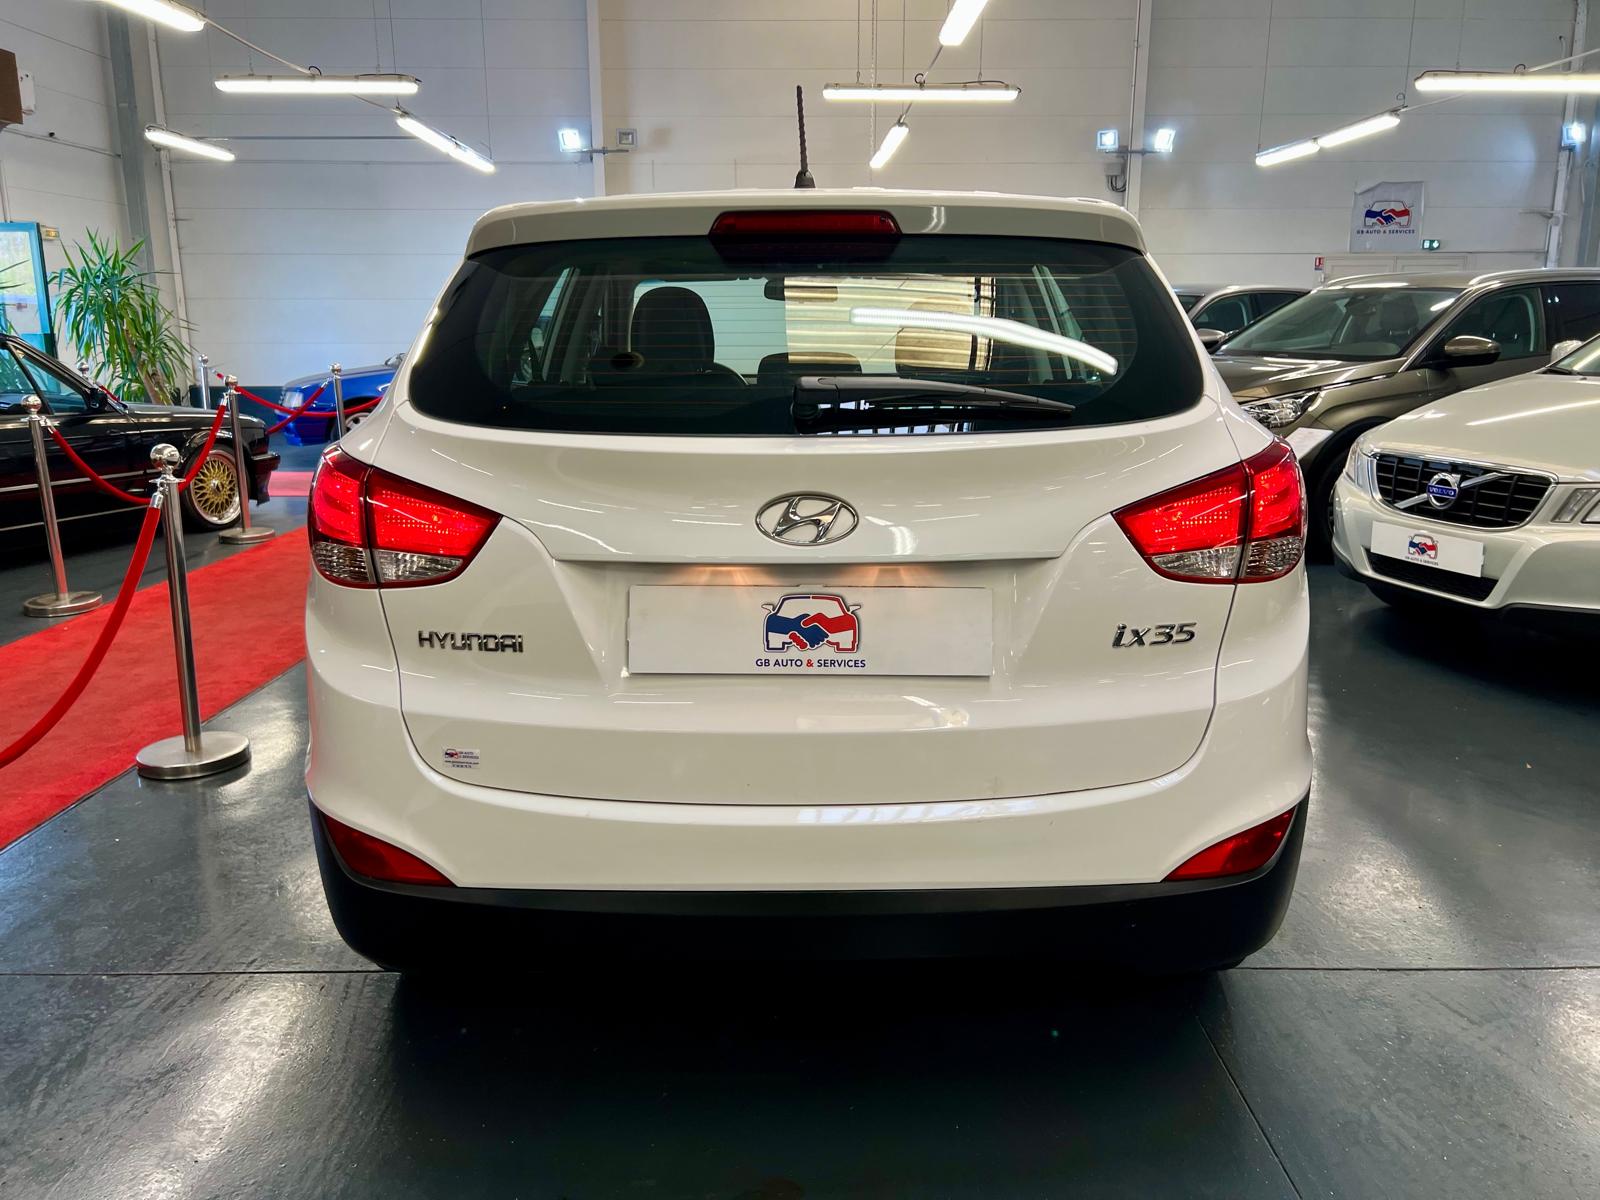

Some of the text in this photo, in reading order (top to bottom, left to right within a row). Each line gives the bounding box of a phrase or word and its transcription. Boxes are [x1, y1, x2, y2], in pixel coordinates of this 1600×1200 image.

[1429, 486, 1455, 496] VOLVO
[1112, 622, 1197, 649] ix35
[755, 658, 867, 669] GB AUTO & SERVICES
